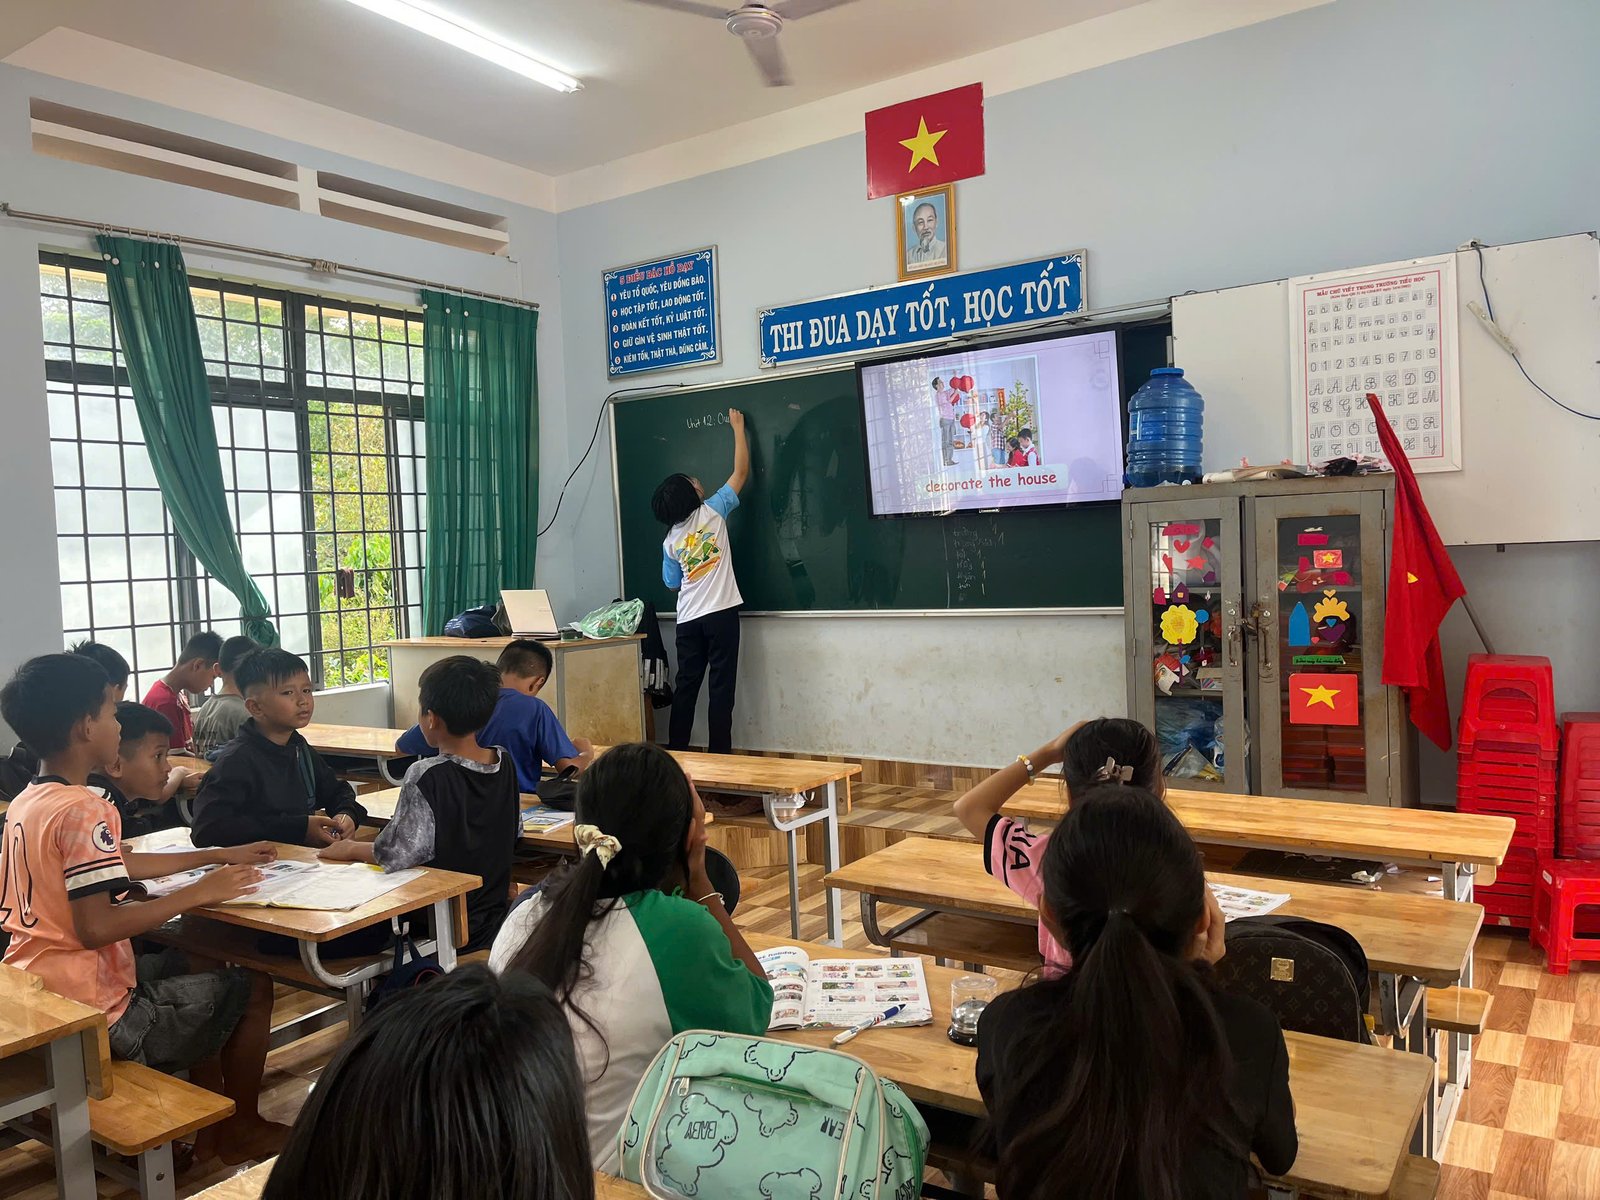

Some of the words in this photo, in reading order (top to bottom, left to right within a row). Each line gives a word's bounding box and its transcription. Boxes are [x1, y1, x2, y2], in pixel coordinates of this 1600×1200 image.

[620, 306, 633, 316] HỌC
[661, 298, 672, 308] LAO
[769, 321, 804, 354] THI
[809, 313, 851, 348] ĐUA
[856, 304, 900, 346] DẠY
[905, 282, 956, 333] TỐT,
[963, 285, 1013, 328] HỌC
[1020, 261, 1071, 315] TỐT
[656, 331, 673, 342] SINH
[1311, 362, 1316, 372] 0
[1336, 359, 1342, 369] 2
[1349, 357, 1355, 368] 3
[1362, 356, 1369, 366] 4
[1375, 354, 1381, 364] 5
[1388, 353, 1395, 363] 6
[1401, 351, 1408, 361] 7
[1415, 350, 1422, 360] 8
[1429, 348, 1436, 358] 9
[925, 478, 983, 493] decorate
[988, 474, 1012, 488] the
[1017, 472, 1057, 486] house
[684, 1121, 717, 1140] BABY
[820, 1115, 846, 1141] EAR
